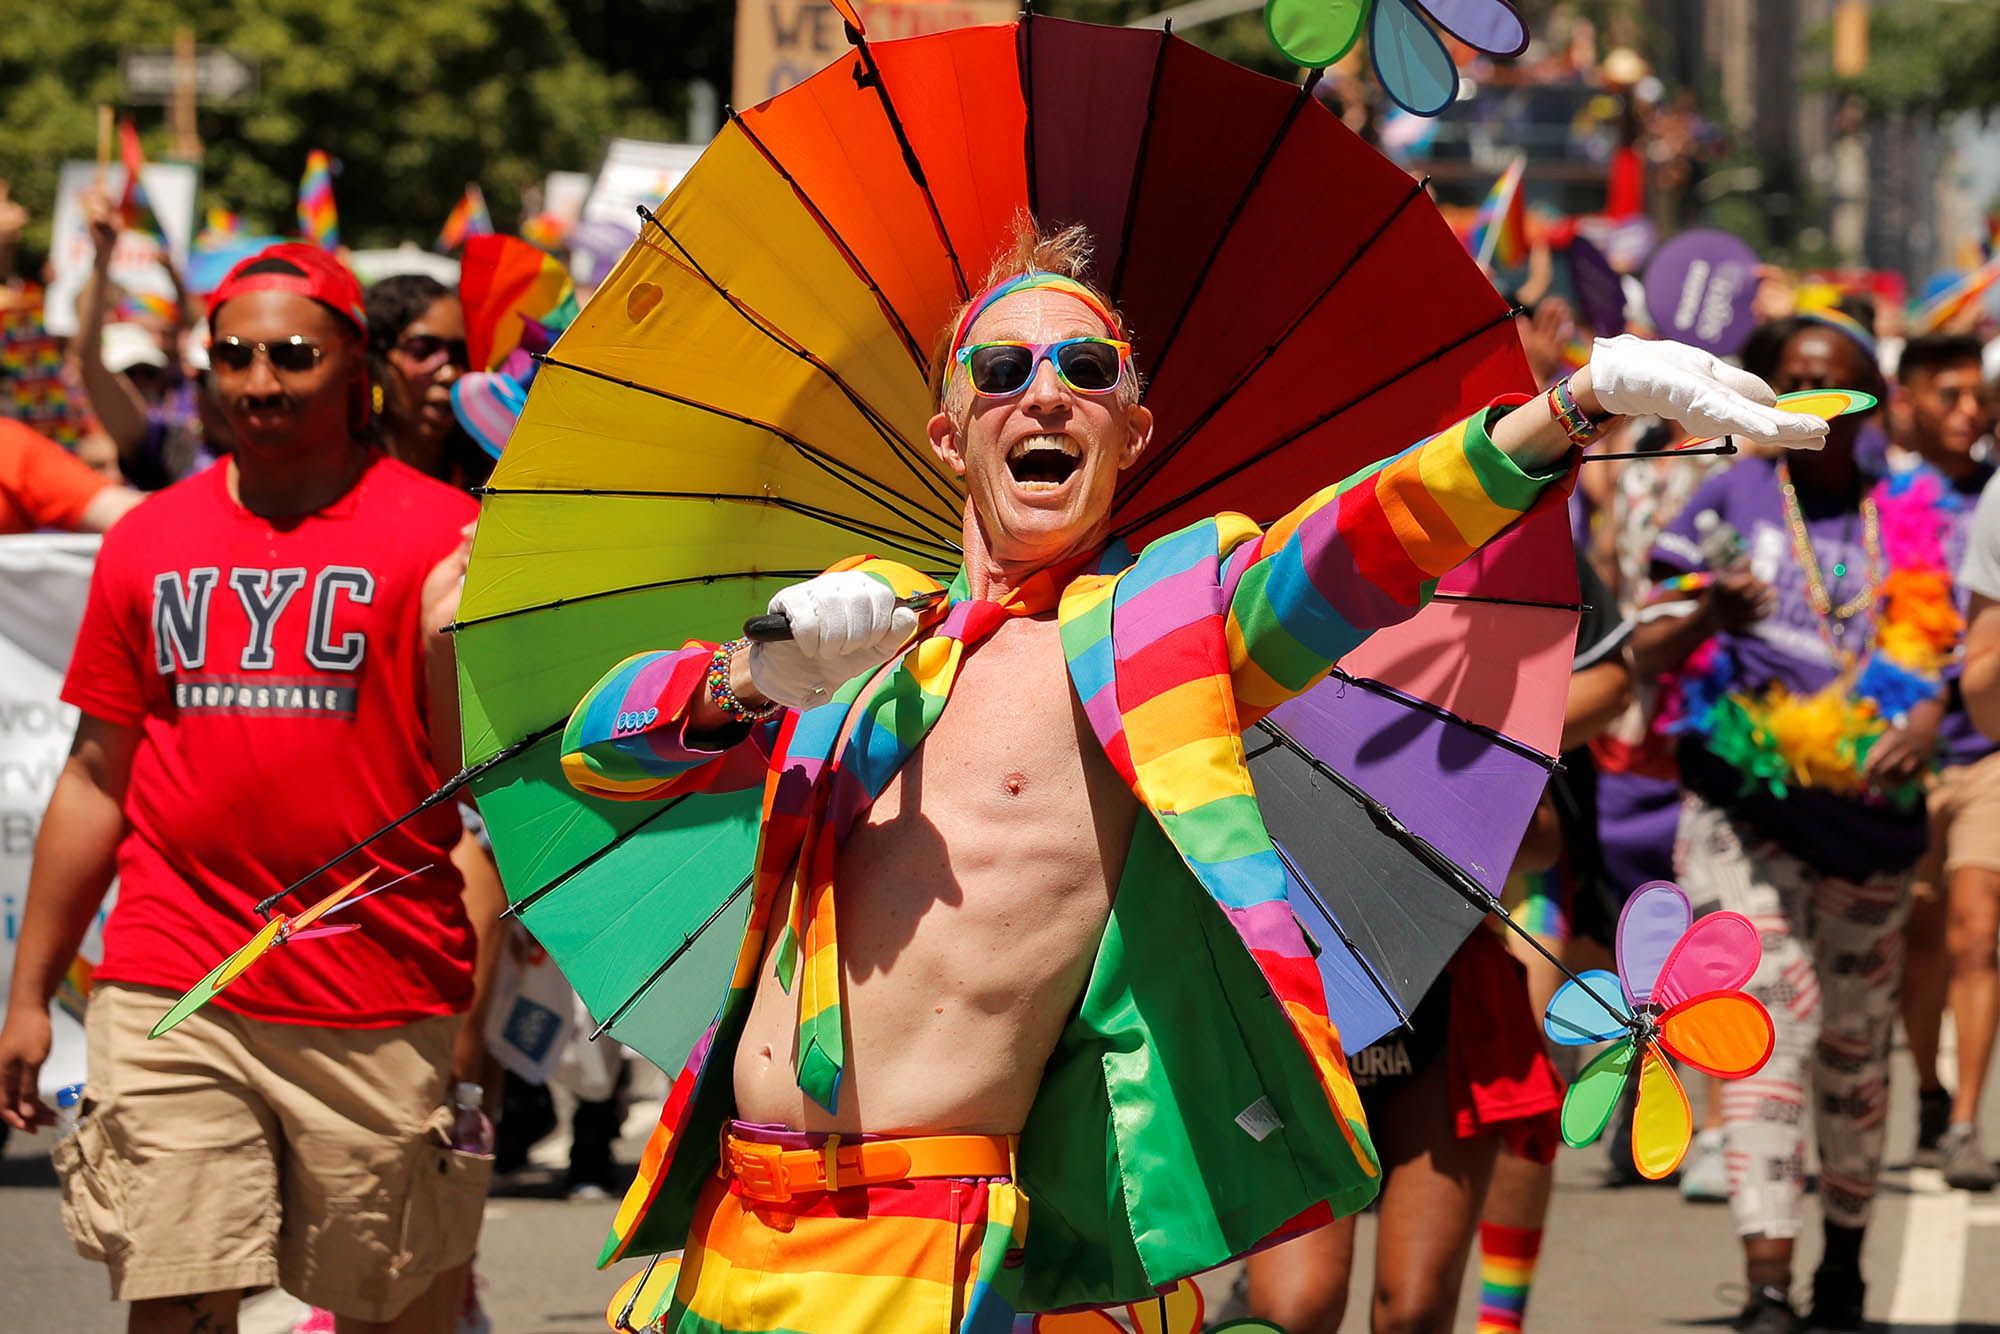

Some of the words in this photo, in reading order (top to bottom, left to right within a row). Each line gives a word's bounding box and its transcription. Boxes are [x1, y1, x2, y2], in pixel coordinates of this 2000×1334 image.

[768, 4, 833, 52] WE
[152, 564, 375, 675] NYC
[176, 683, 338, 711] EROPOSTALE
